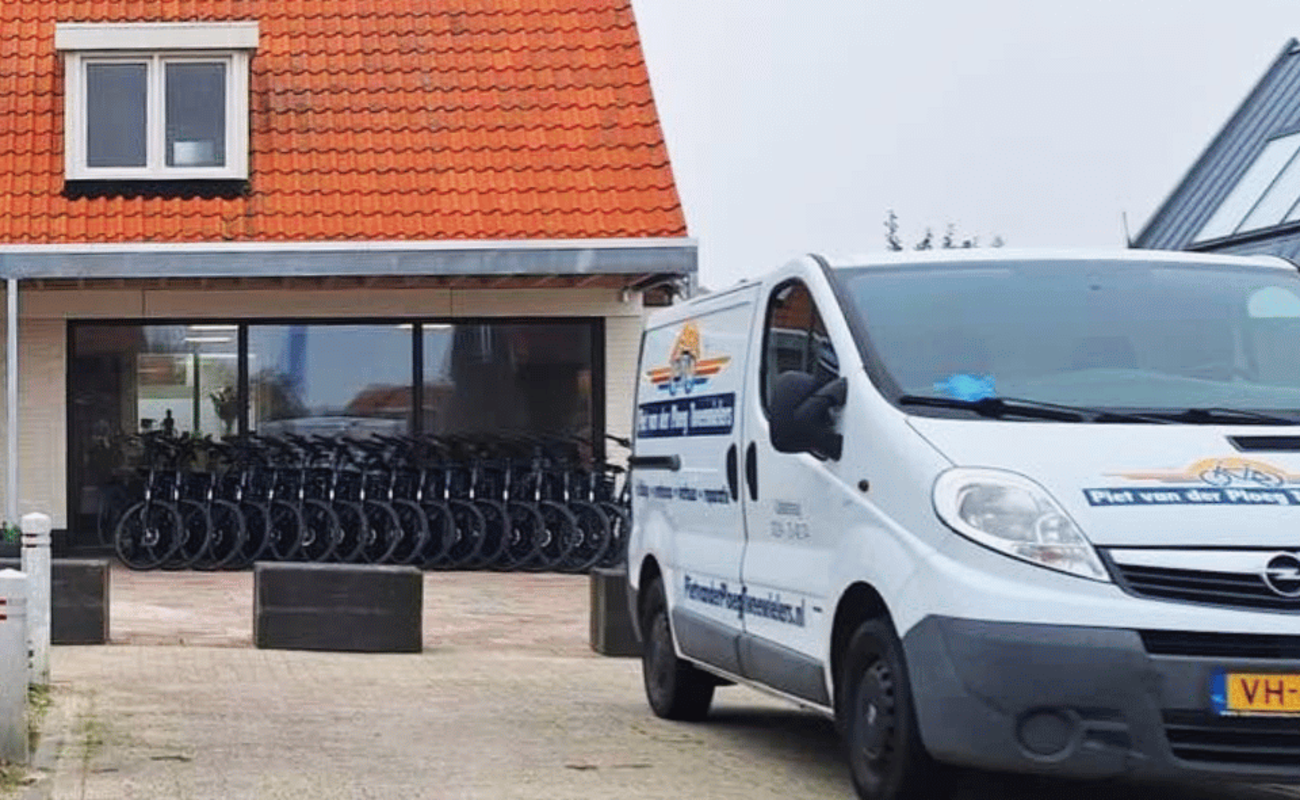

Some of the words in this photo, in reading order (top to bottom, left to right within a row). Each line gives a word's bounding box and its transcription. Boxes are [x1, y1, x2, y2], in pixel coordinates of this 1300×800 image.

[1089, 489, 1134, 504] Piet
[1138, 491, 1180, 503] van
[1183, 489, 1221, 502] der
[1224, 489, 1289, 505] Ploeg
